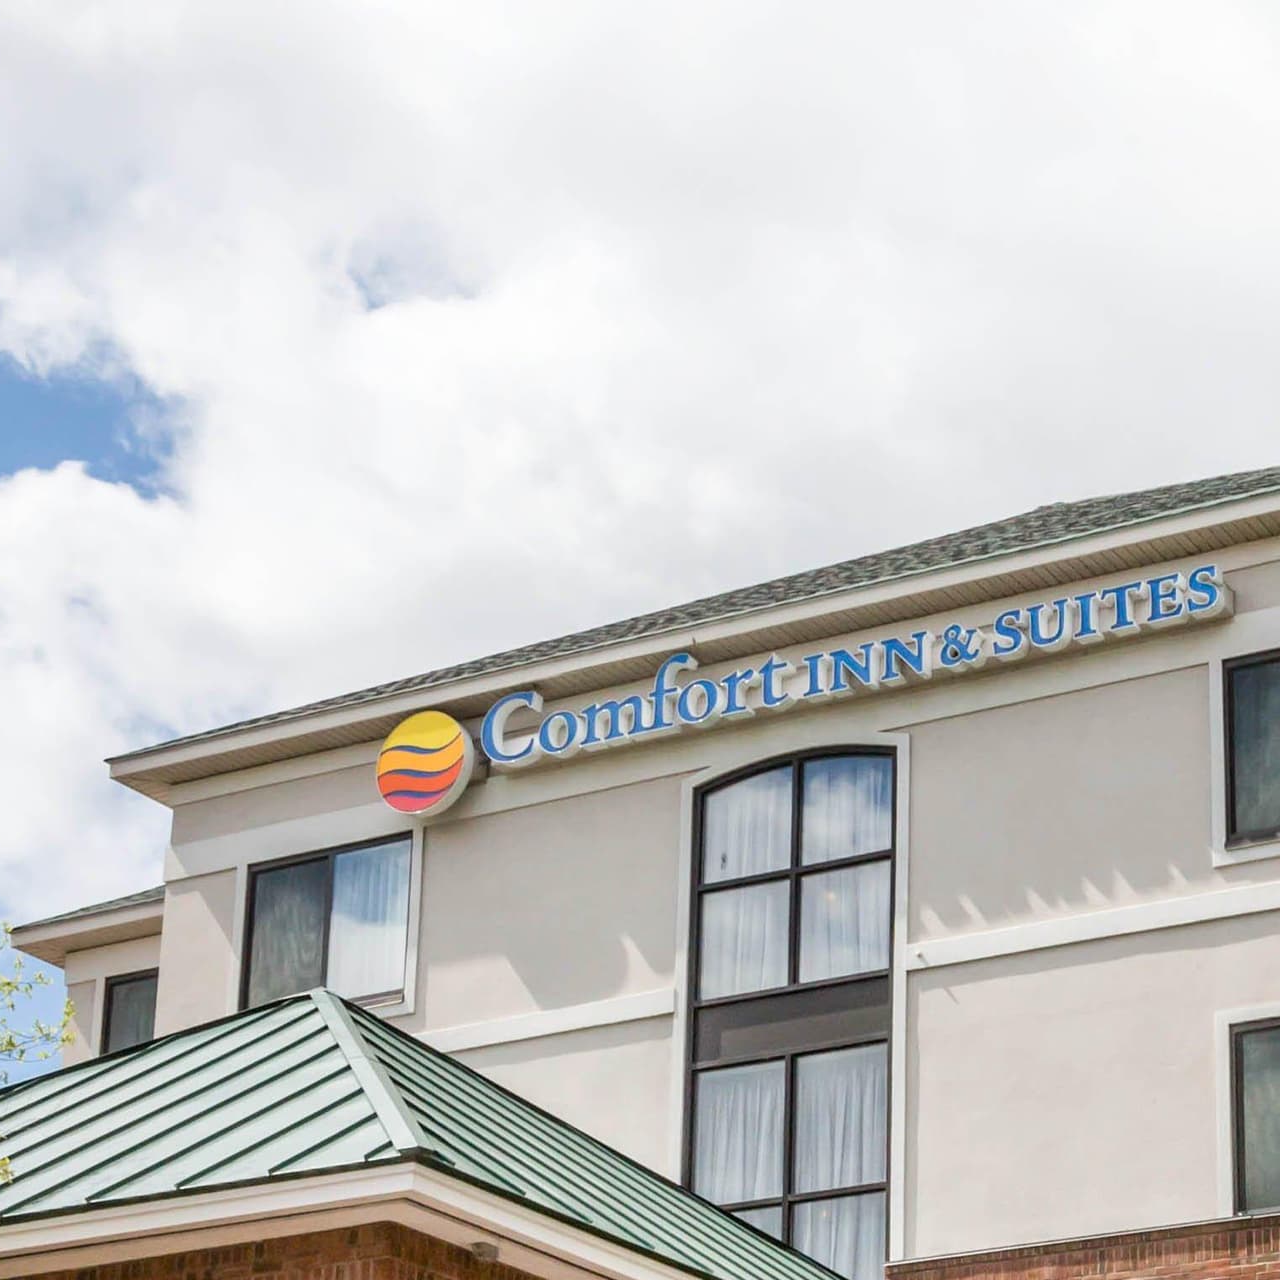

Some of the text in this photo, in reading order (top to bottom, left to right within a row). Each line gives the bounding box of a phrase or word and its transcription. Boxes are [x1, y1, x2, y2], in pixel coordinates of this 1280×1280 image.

[481, 565, 1219, 762] Comfort INN & SUITES
